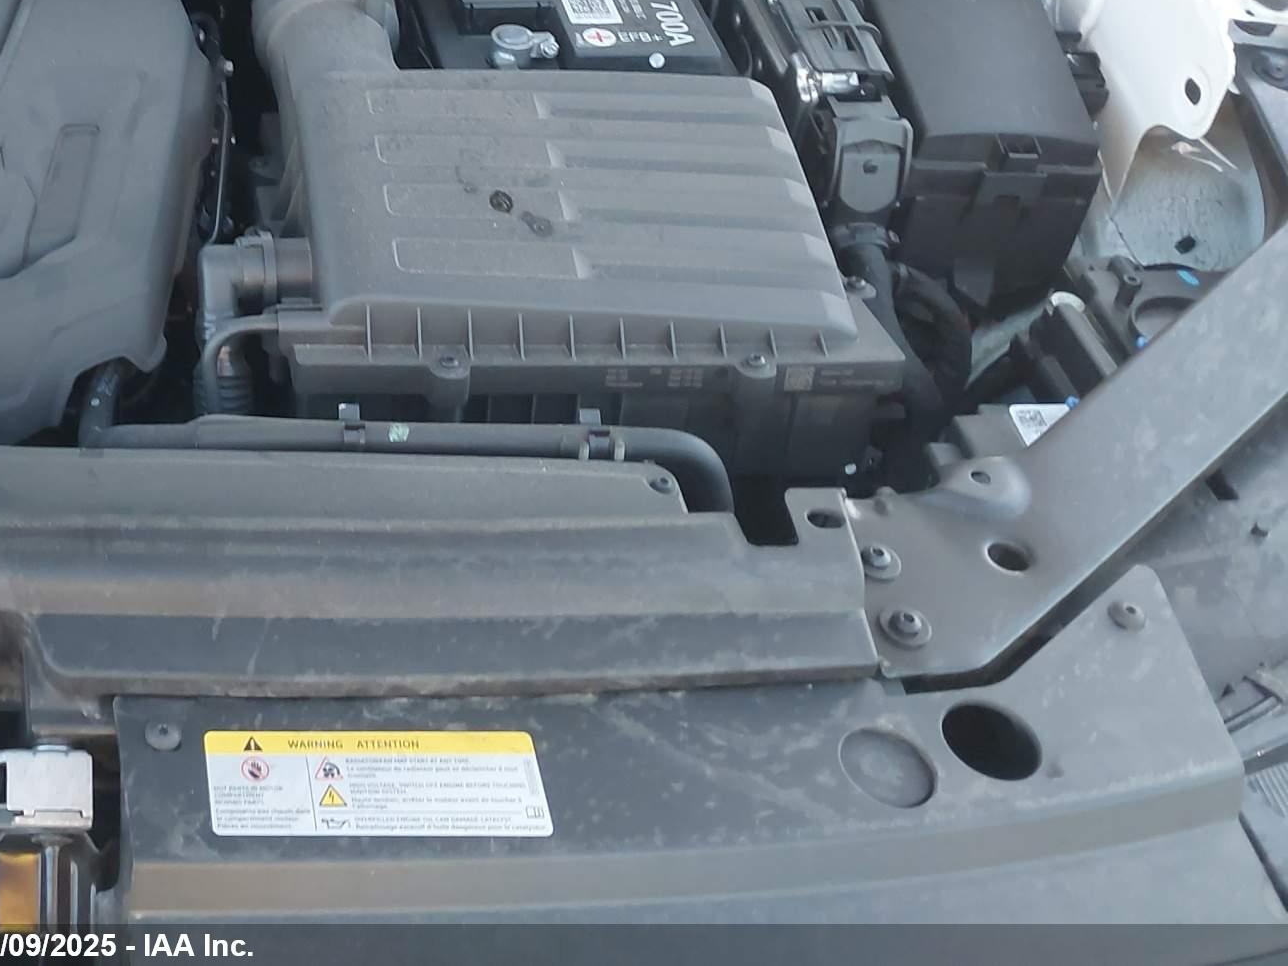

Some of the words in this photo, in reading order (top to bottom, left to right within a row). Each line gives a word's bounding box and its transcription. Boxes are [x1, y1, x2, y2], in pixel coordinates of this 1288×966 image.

[650, 1, 695, 46] 700A
[288, 739, 343, 750] WARNING
[357, 739, 420, 750] ATTENTION
